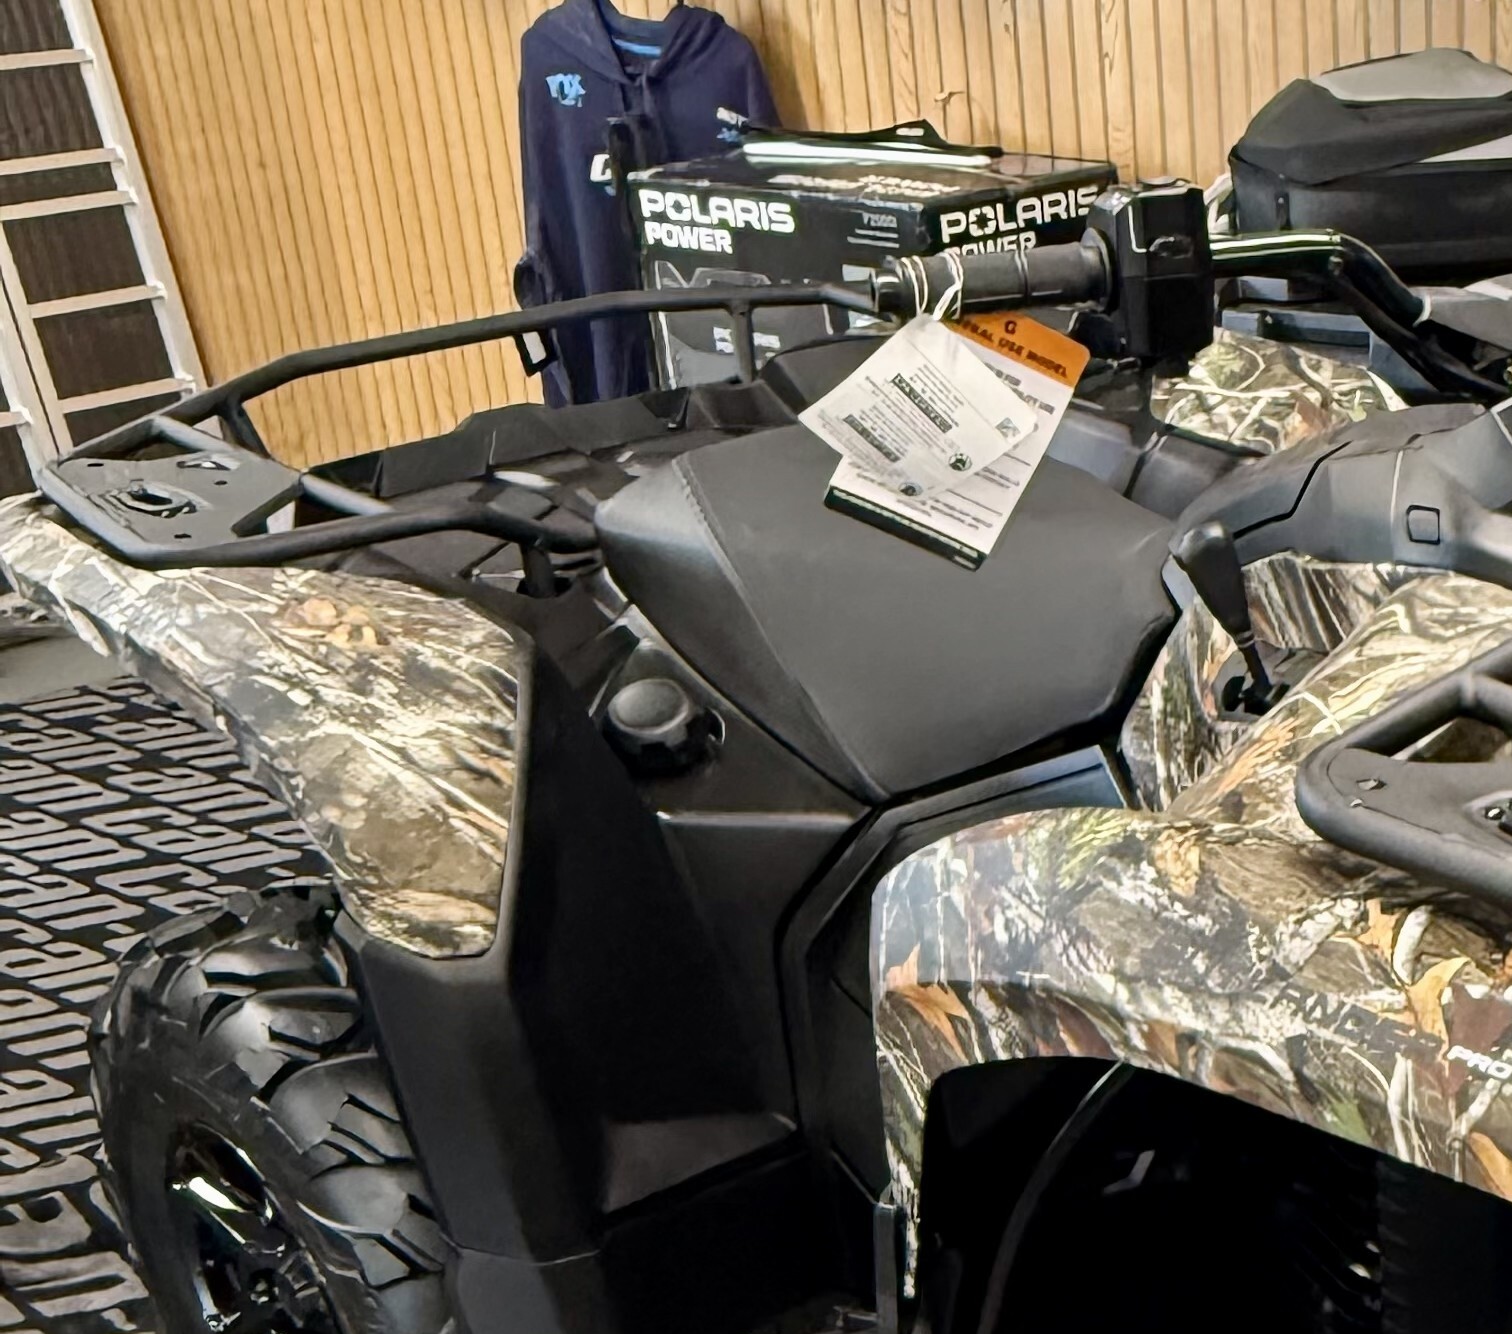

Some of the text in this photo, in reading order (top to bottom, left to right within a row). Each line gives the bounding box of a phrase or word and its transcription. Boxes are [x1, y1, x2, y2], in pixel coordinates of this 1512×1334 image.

[638, 189, 795, 233] POLARIS
[940, 184, 1099, 243] POLARIS
[644, 221, 733, 254] POWER
